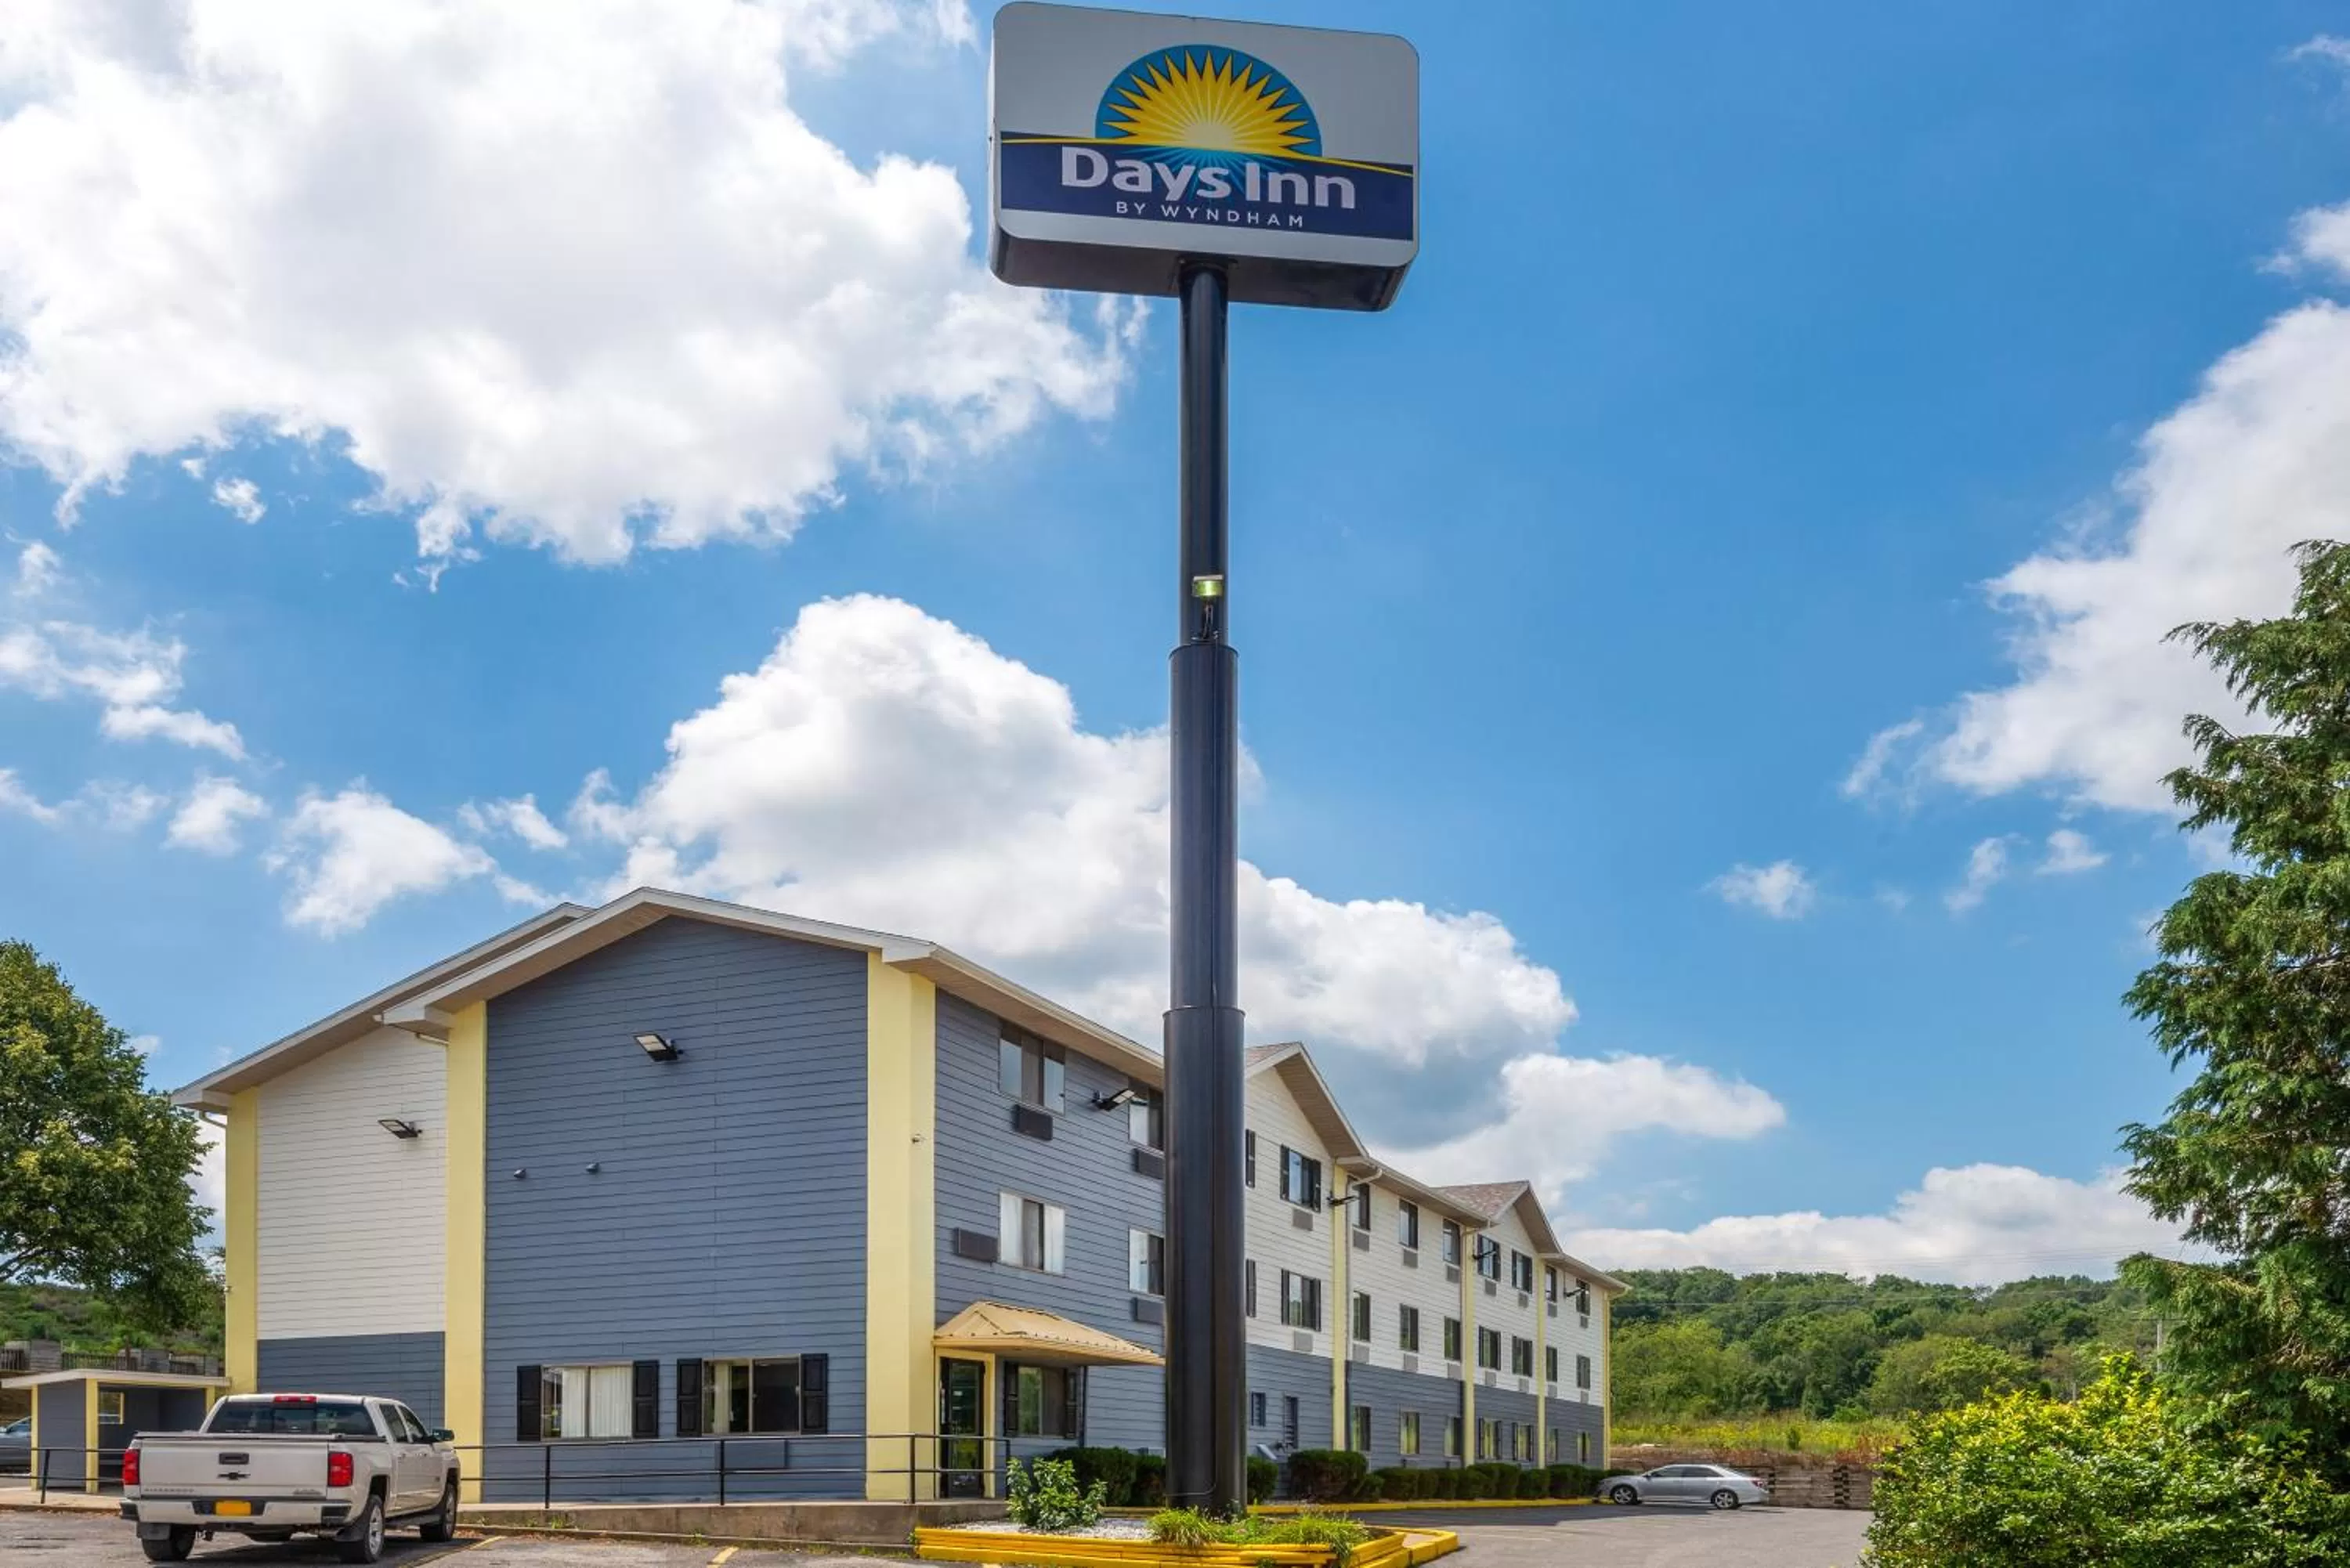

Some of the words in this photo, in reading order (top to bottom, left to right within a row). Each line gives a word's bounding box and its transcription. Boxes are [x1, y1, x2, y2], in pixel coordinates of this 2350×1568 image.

[1061, 146, 1231, 201] Days
[1245, 163, 1355, 209] Inn
[1116, 201, 1146, 215] BY
[1161, 205, 1303, 228] WYNDHAM
